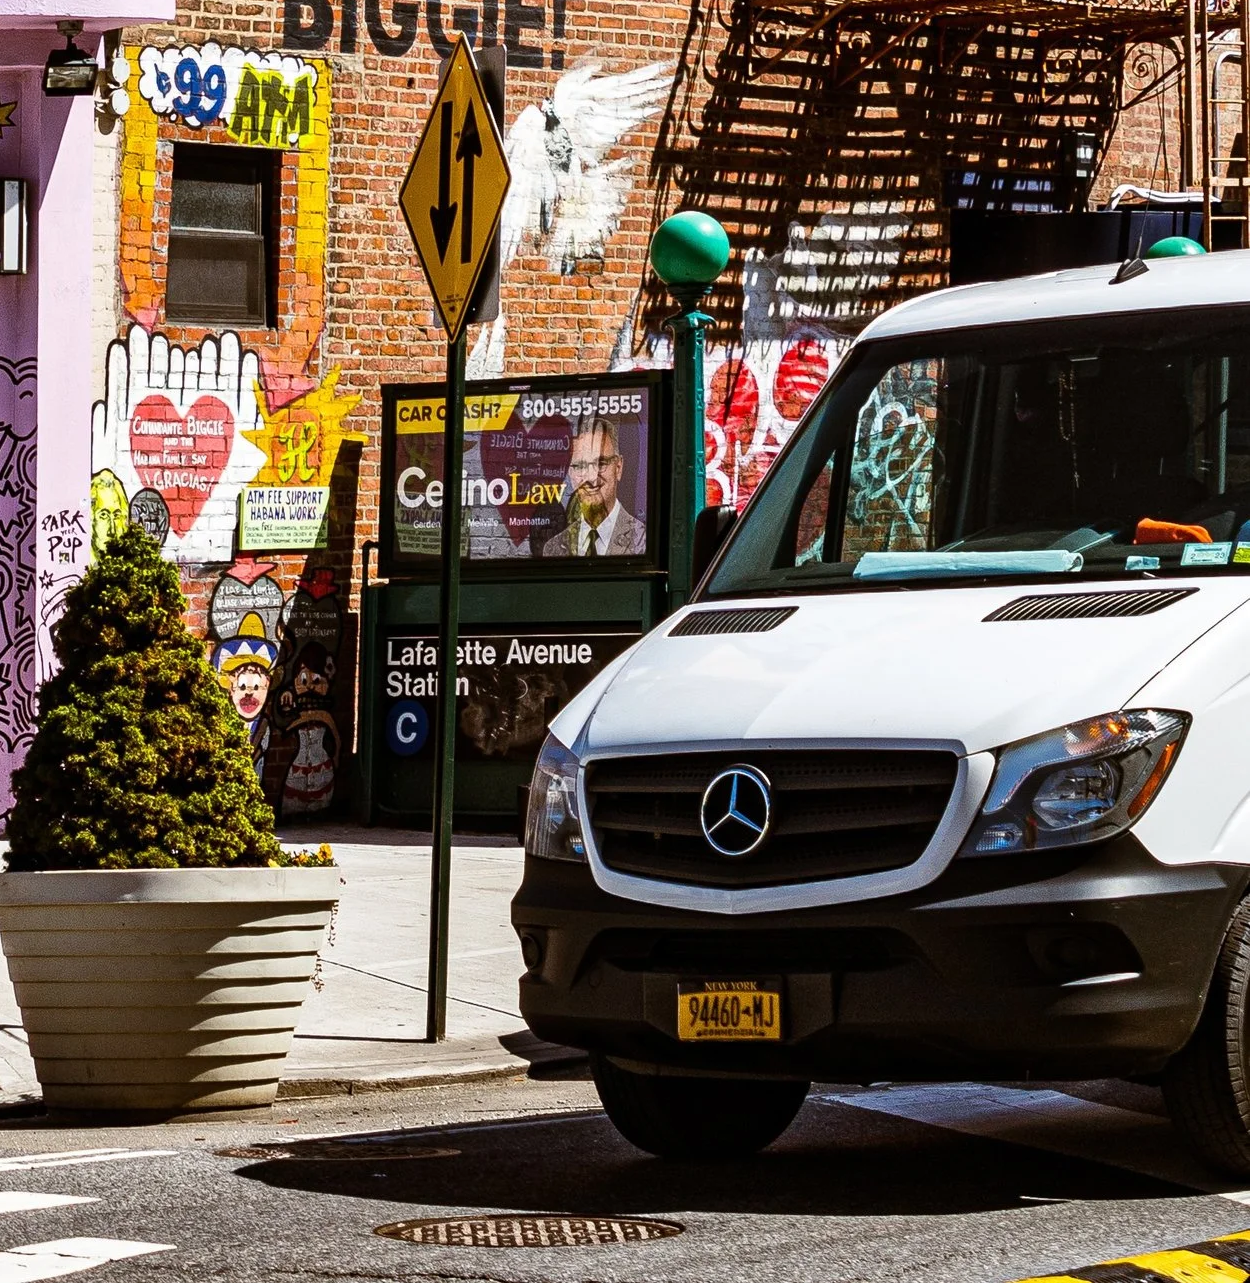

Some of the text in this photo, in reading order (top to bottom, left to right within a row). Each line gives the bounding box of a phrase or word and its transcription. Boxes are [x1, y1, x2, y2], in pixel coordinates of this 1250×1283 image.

[229, 65, 313, 146] ATM
[399, 394, 642, 423] CAR CASH? 800-555-5555
[187, 416, 224, 435] BIGGIE
[163, 437, 194, 446] AND THE
[163, 449, 186, 466] FAMILY
[191, 453, 207, 465] SAY
[246, 490, 323, 505] ATM FEE SUPPORT
[397, 466, 567, 509] CeinoLaw
[41, 509, 86, 534] PARK
[250, 506, 286, 521] HABANA
[413, 516, 550, 529] Garden Melville Manhattan
[47, 535, 83, 563] PUP
[387, 639, 592, 666] Lafaette Avenue
[386, 670, 469, 697] Statin
[396, 712, 417, 744] C
[705, 981, 757, 991] NEW YORK
